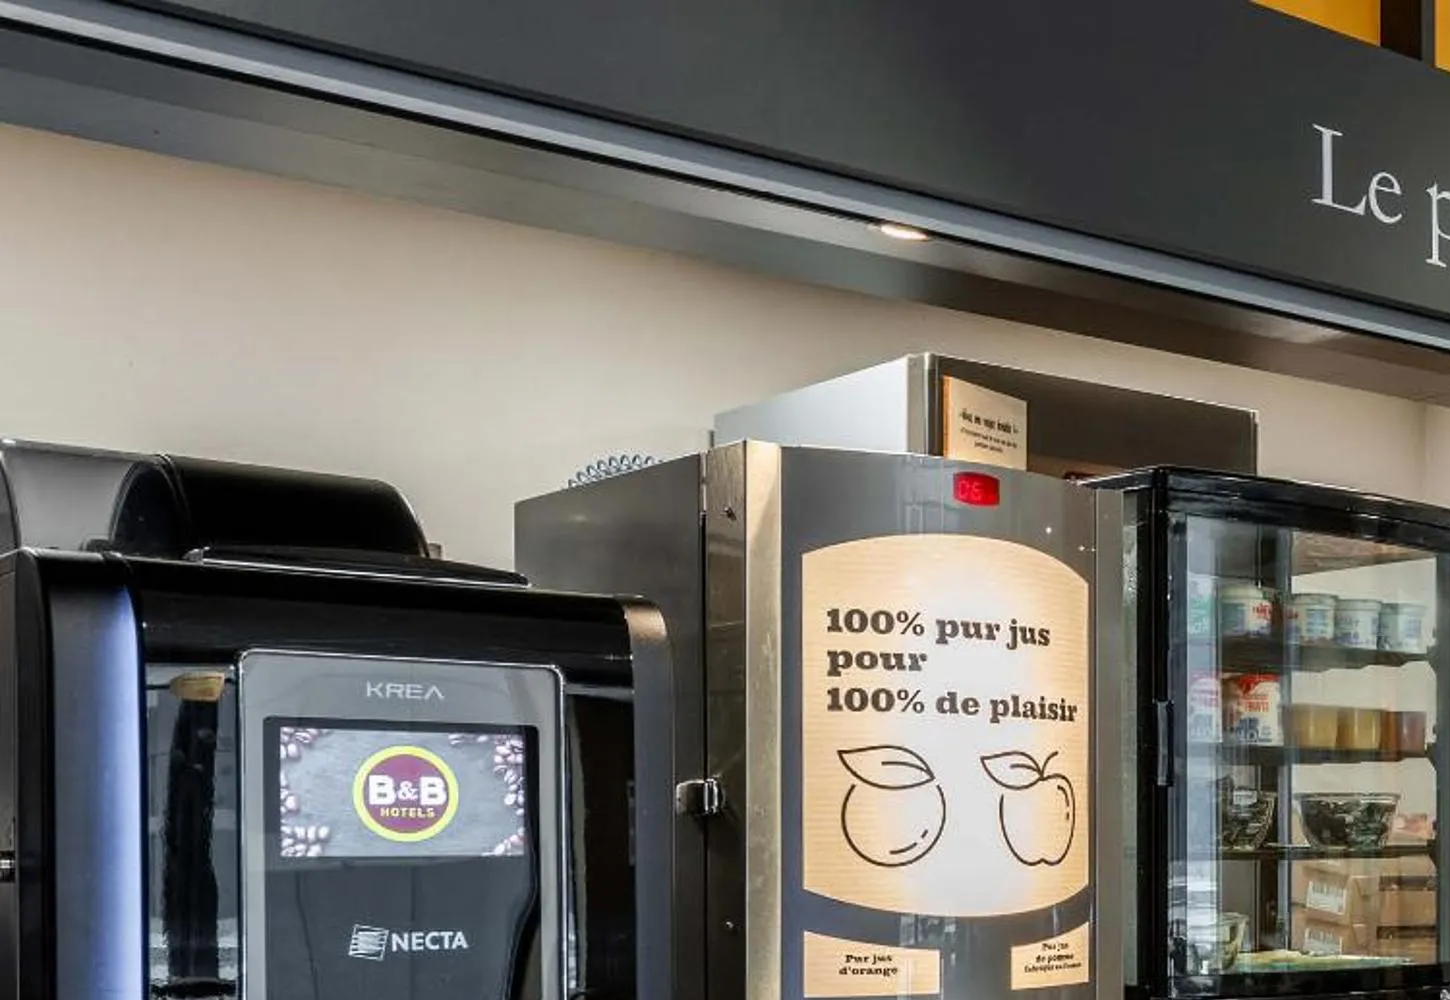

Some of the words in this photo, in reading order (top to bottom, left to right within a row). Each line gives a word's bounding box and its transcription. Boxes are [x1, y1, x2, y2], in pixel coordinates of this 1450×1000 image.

[1311, 123, 1403, 225] Le
[826, 608, 925, 636] 100%
[935, 618, 1001, 645] pur
[1006, 618, 1051, 650] jus
[826, 650, 928, 677] pour
[366, 680, 445, 700] KREA
[826, 687, 925, 714] 100%
[935, 691, 981, 716] de
[989, 694, 1079, 724] plaisir
[368, 775, 448, 806] B&B
[380, 807, 436, 818] HOTELS
[391, 931, 470, 952] NECTA
[845, 954, 870, 964] Pur
[872, 953, 893, 965] jus
[838, 965, 899, 978] d'orange
